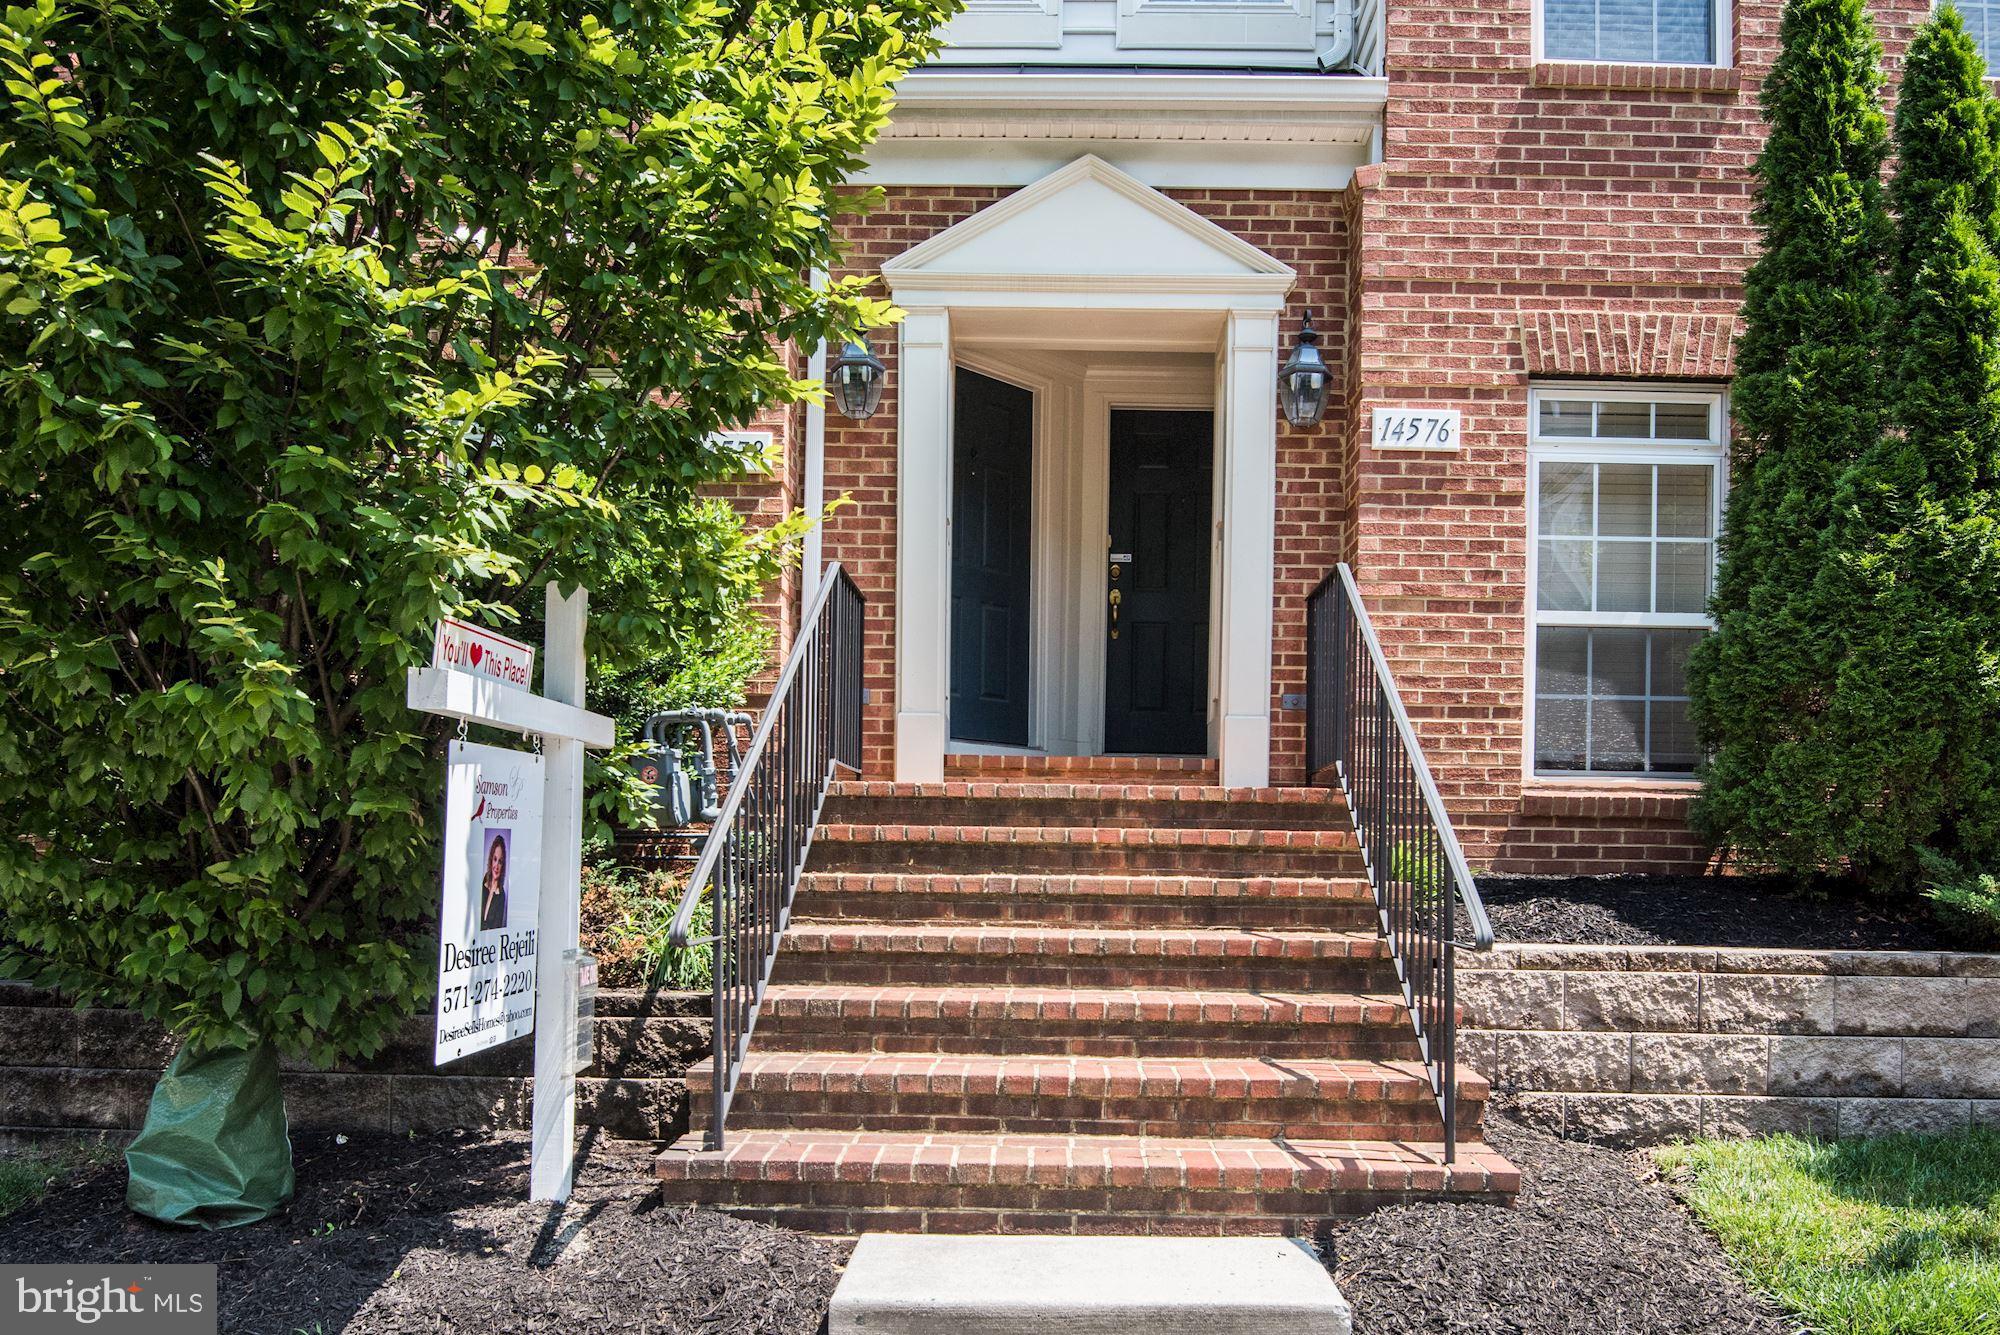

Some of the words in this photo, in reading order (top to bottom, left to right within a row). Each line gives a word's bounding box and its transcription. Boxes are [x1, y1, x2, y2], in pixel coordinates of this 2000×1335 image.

[1380, 416, 1451, 442] 14576
[443, 635, 469, 667] You'll
[484, 649, 502, 678] This
[502, 656, 529, 686] Place!
[475, 774, 508, 797] Samson
[486, 801, 519, 824] Properties
[443, 938, 497, 973] Desiree
[499, 929, 535, 965] Rejeili
[443, 969, 532, 1014] 571-274-2220
